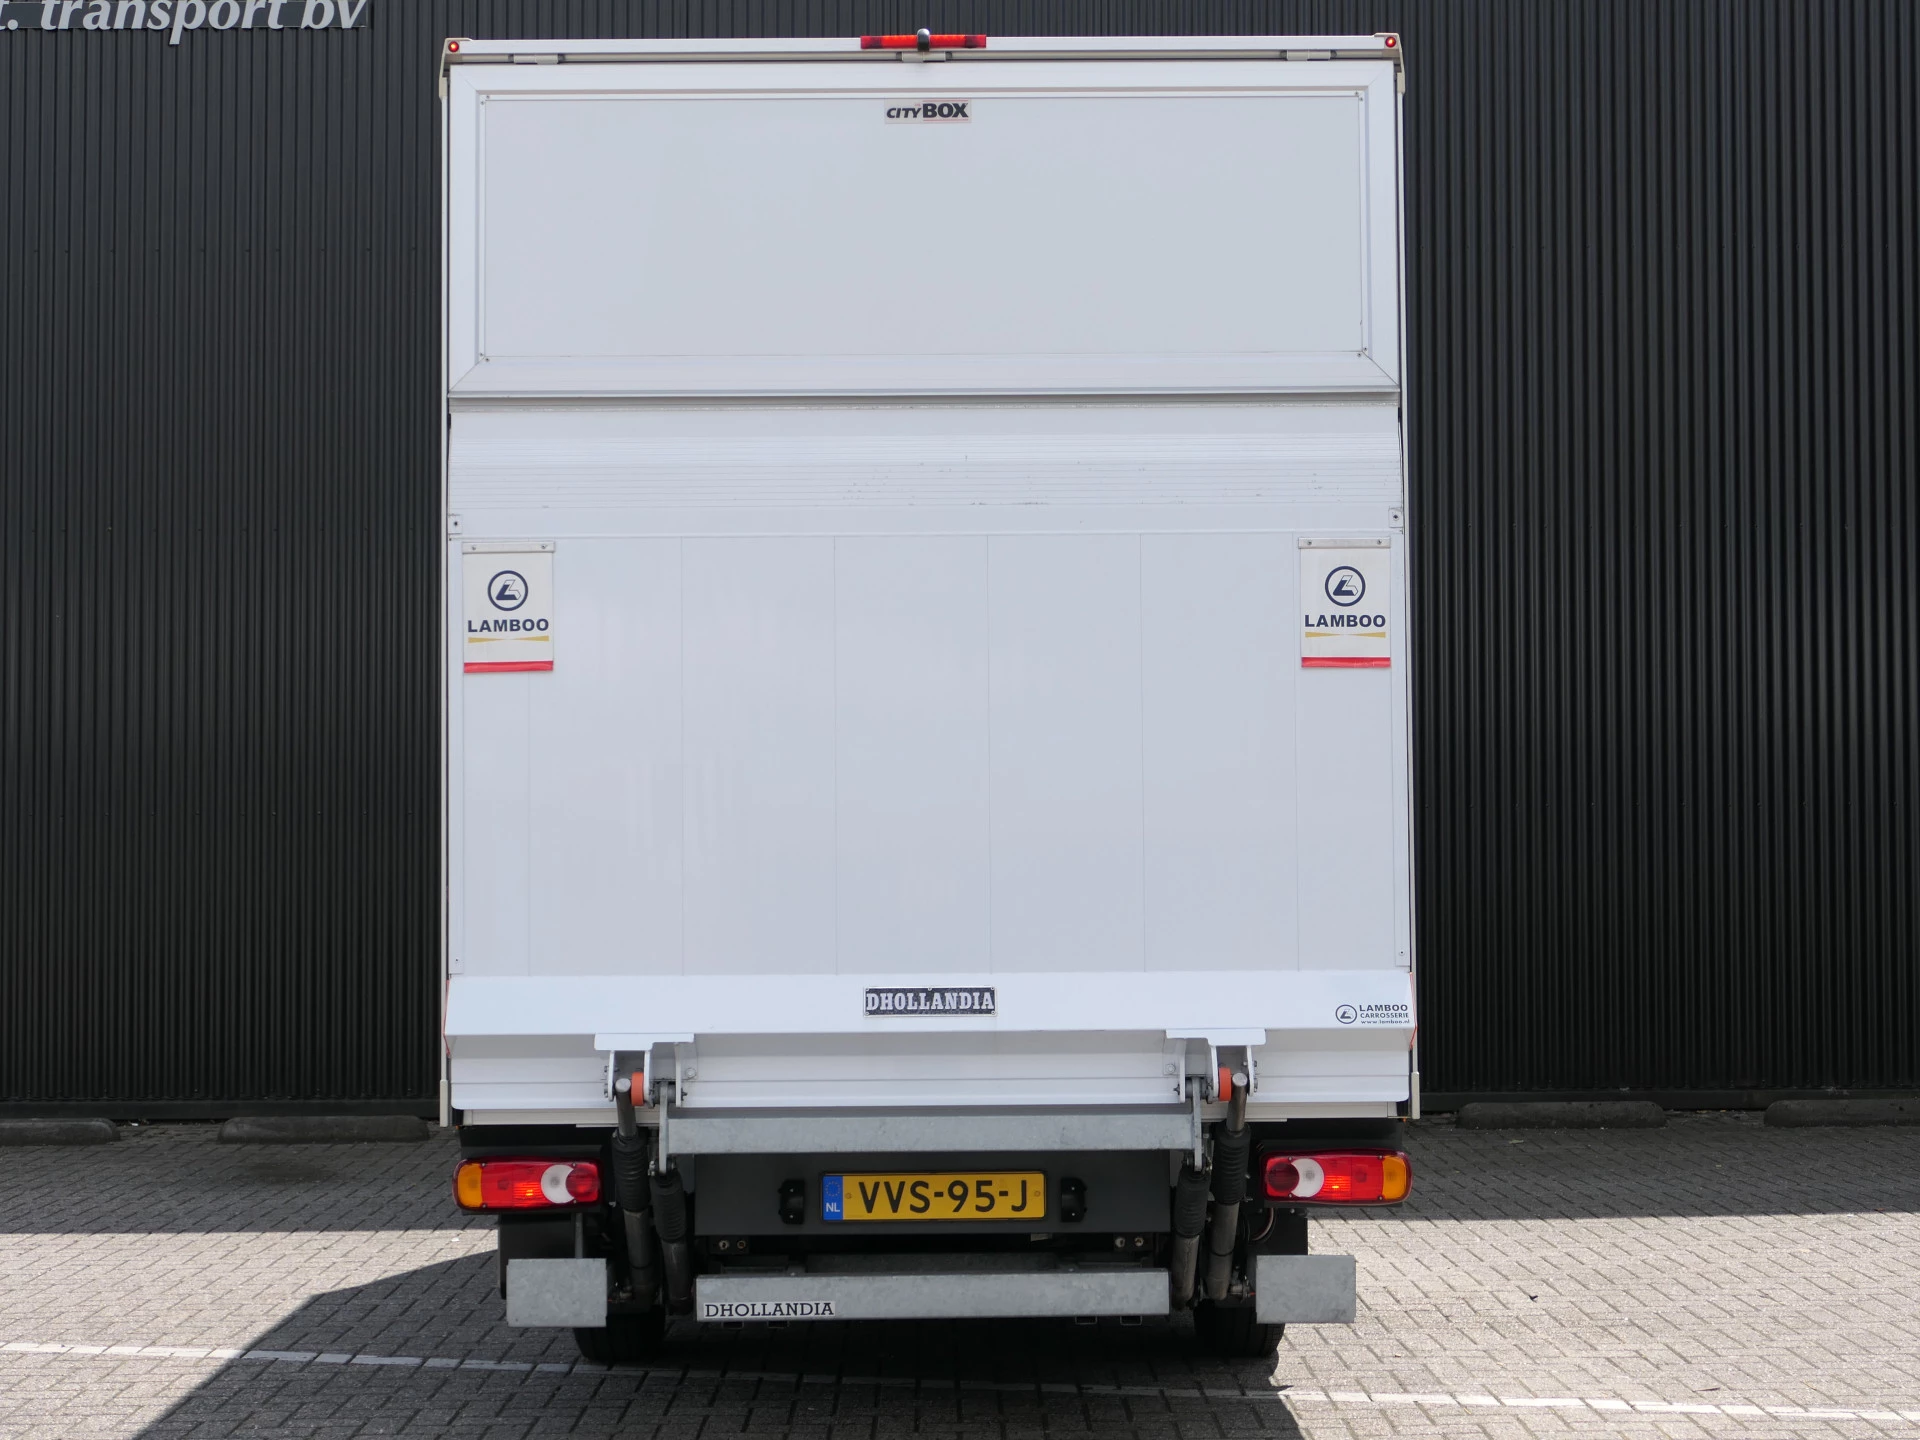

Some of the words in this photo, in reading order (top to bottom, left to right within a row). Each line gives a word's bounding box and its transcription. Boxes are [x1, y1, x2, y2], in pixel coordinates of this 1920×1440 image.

[40, 0, 286, 45] transport
[300, 0, 366, 30] bv
[467, 618, 549, 633] LAMBOO
[1304, 614, 1386, 628] LAMBOO
[866, 992, 994, 1011] DHOLLANDIA
[1359, 1004, 1408, 1012] LAMBOO
[826, 1202, 840, 1213] NL
[858, 1180, 1028, 1213] VVS-95-J
[705, 1302, 834, 1317] DHOLLANDIA
